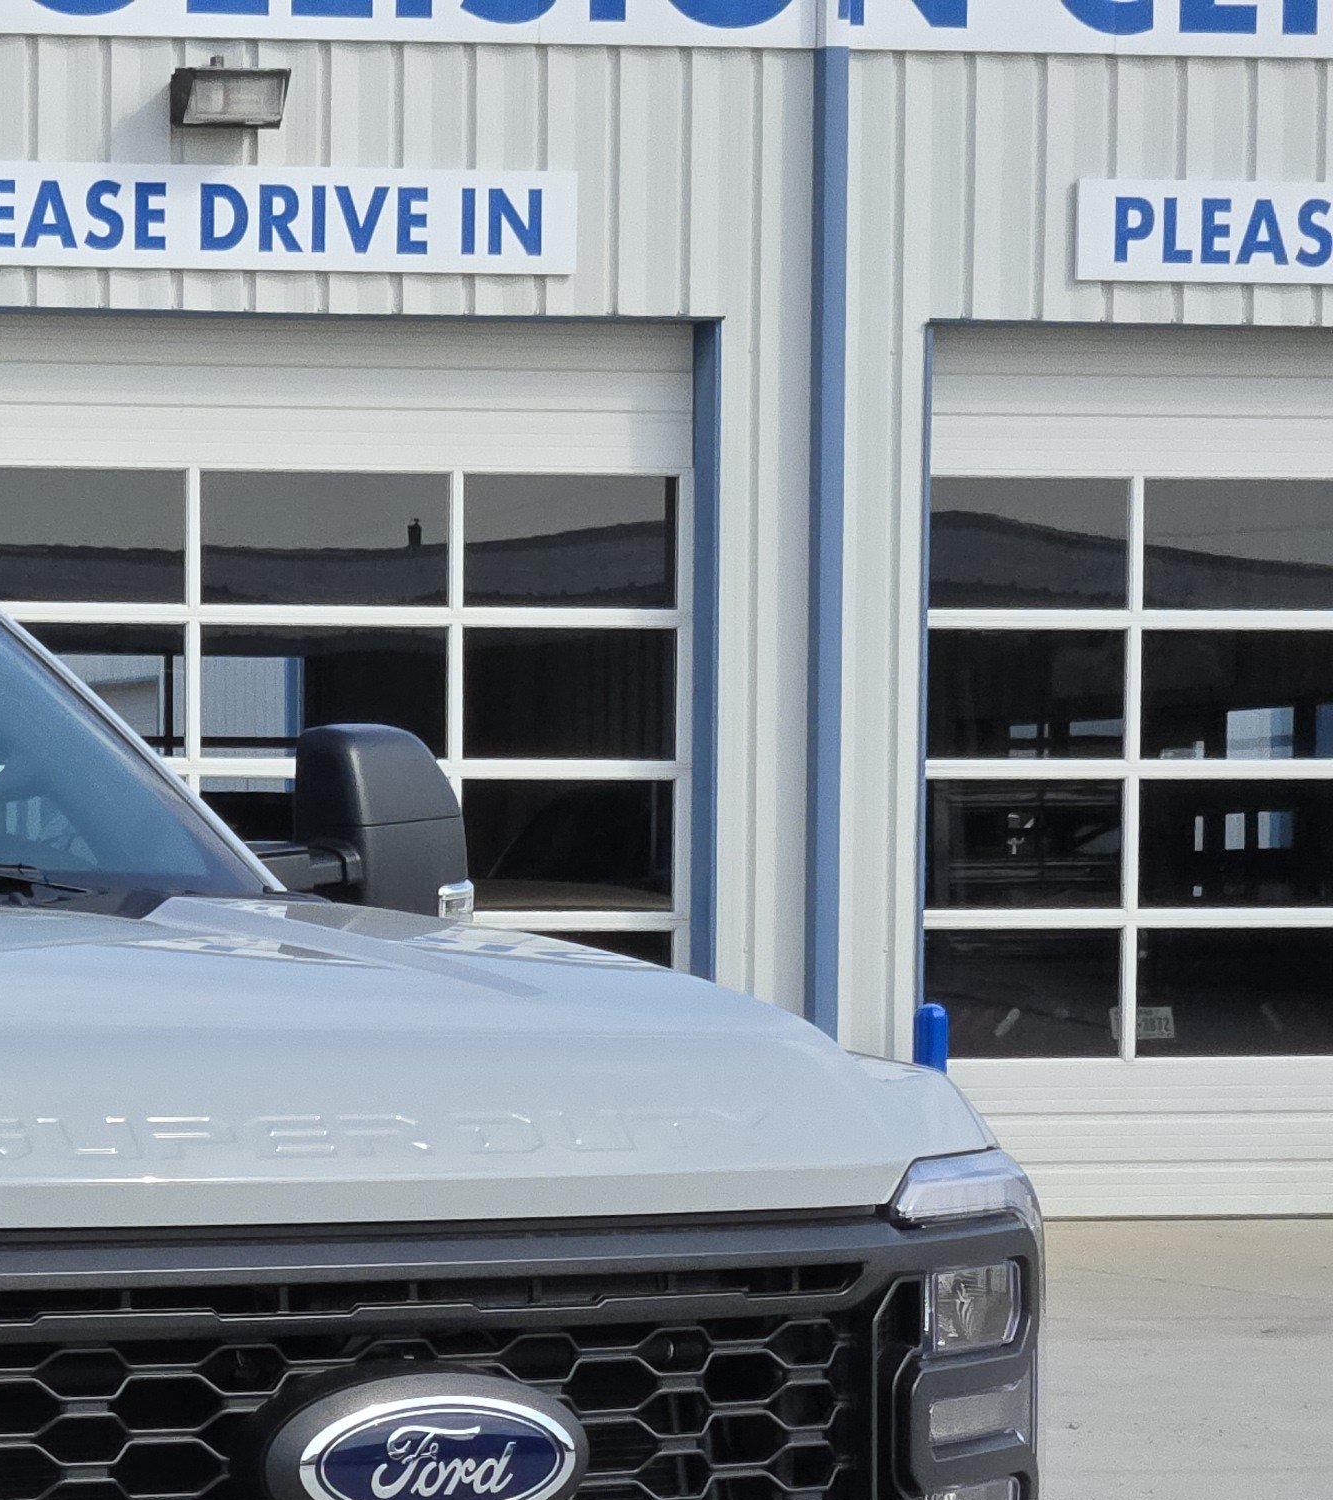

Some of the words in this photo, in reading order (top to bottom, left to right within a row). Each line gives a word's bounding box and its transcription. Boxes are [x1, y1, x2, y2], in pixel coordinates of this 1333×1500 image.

[199, 183, 429, 255] DRIVE
[460, 187, 543, 257] IN
[1113, 196, 1333, 267] PLEAS
[443, 1107, 769, 1156] DUTY
[371, 1424, 517, 1499] Ford
